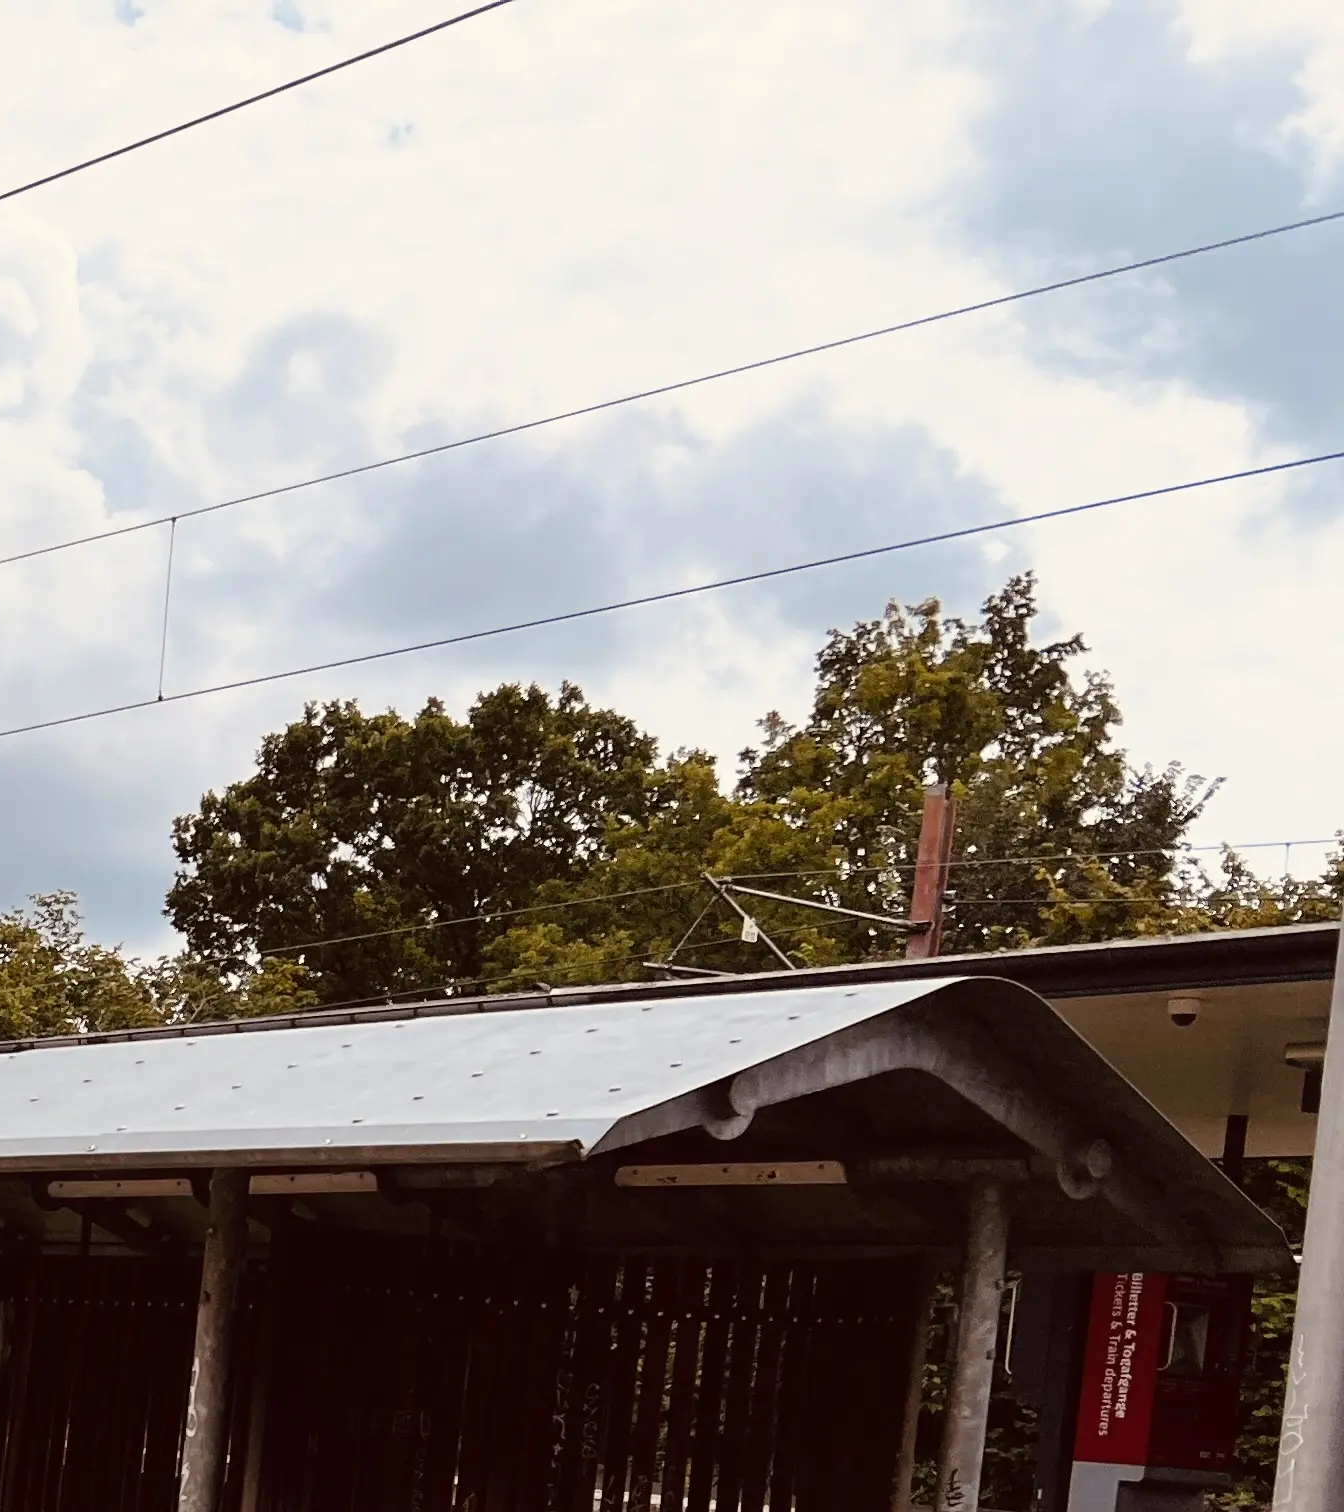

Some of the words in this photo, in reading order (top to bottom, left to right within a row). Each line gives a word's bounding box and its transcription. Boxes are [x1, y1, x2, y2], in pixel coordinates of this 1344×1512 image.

[1112, 1274, 1128, 1317] Tickets
[1127, 1273, 1143, 1325] Billetter
[1110, 1321, 1123, 1330] &
[1124, 1329, 1136, 1340] &
[1105, 1335, 1121, 1365] Train
[1115, 1342, 1135, 1418] Togafgange
[1098, 1368, 1116, 1436] departures
